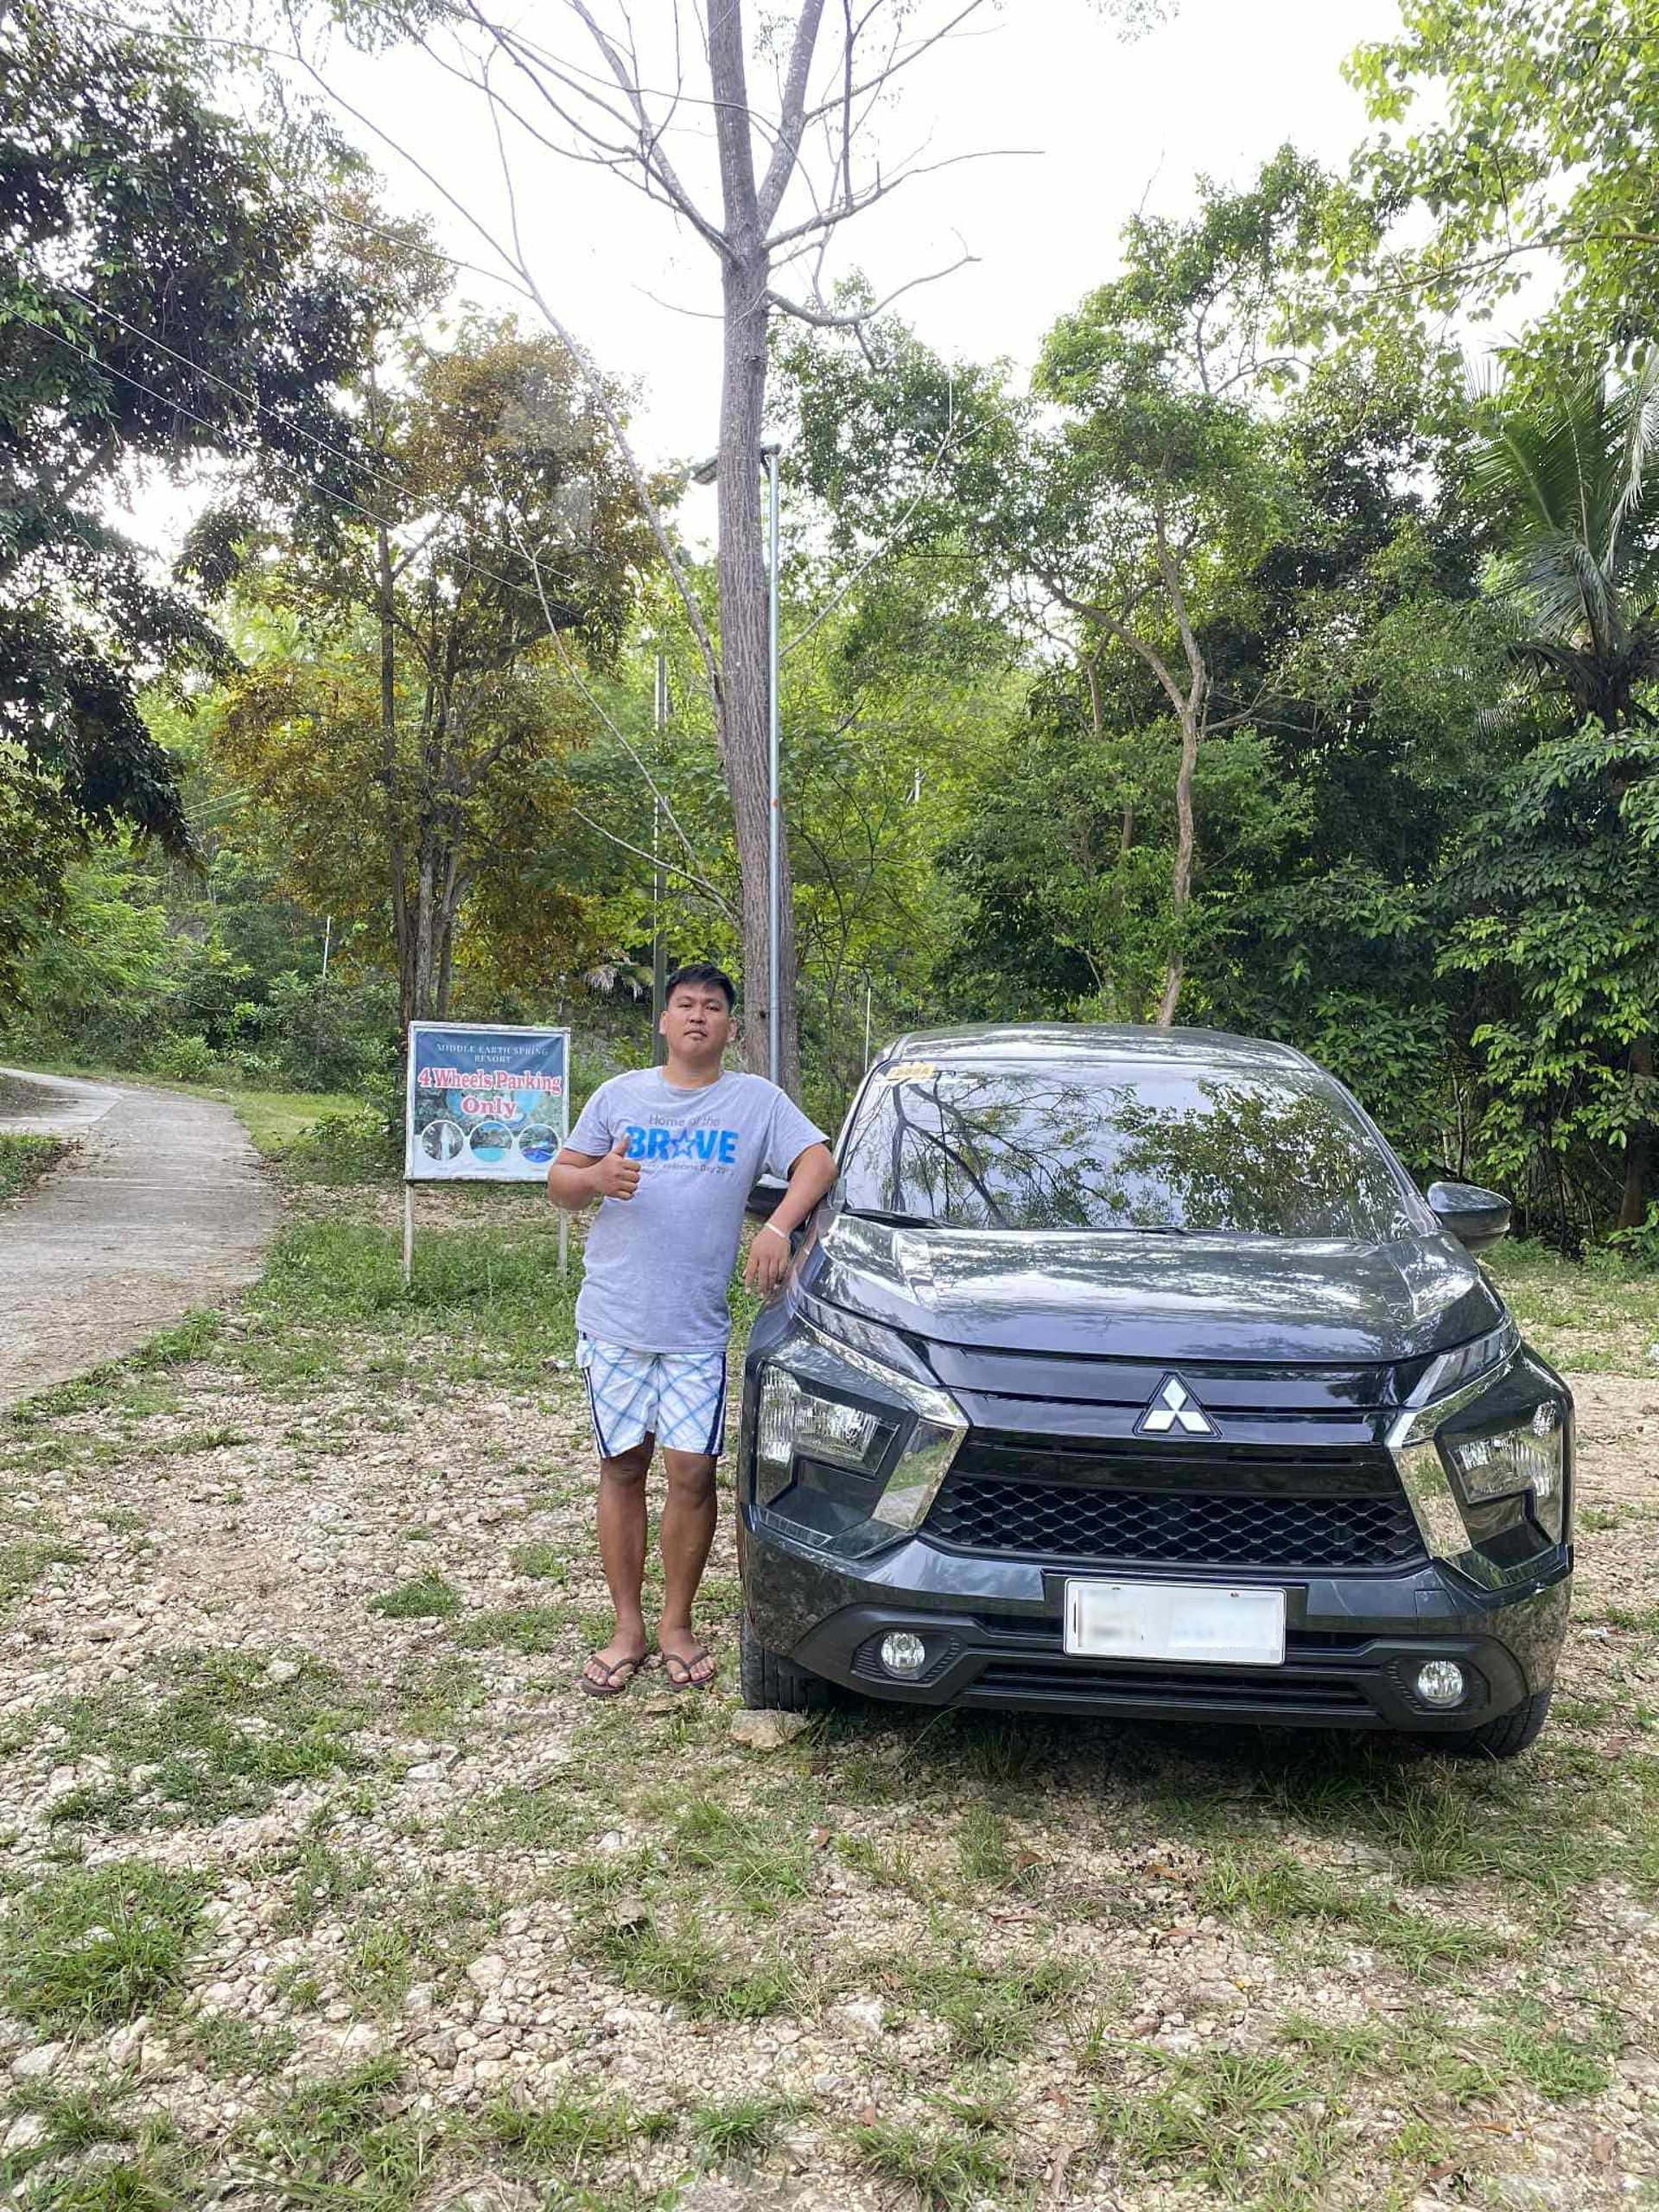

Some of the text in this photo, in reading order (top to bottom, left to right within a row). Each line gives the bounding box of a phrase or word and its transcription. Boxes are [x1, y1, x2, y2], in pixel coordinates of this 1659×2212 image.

[436, 1043, 549, 1056] MIDDLE EARTH SPRING
[474, 1055, 511, 1064] RESORT
[418, 1067, 562, 1096] 4 Wheels Parking
[461, 1096, 517, 1119] Only
[650, 1114, 685, 1127] Home
